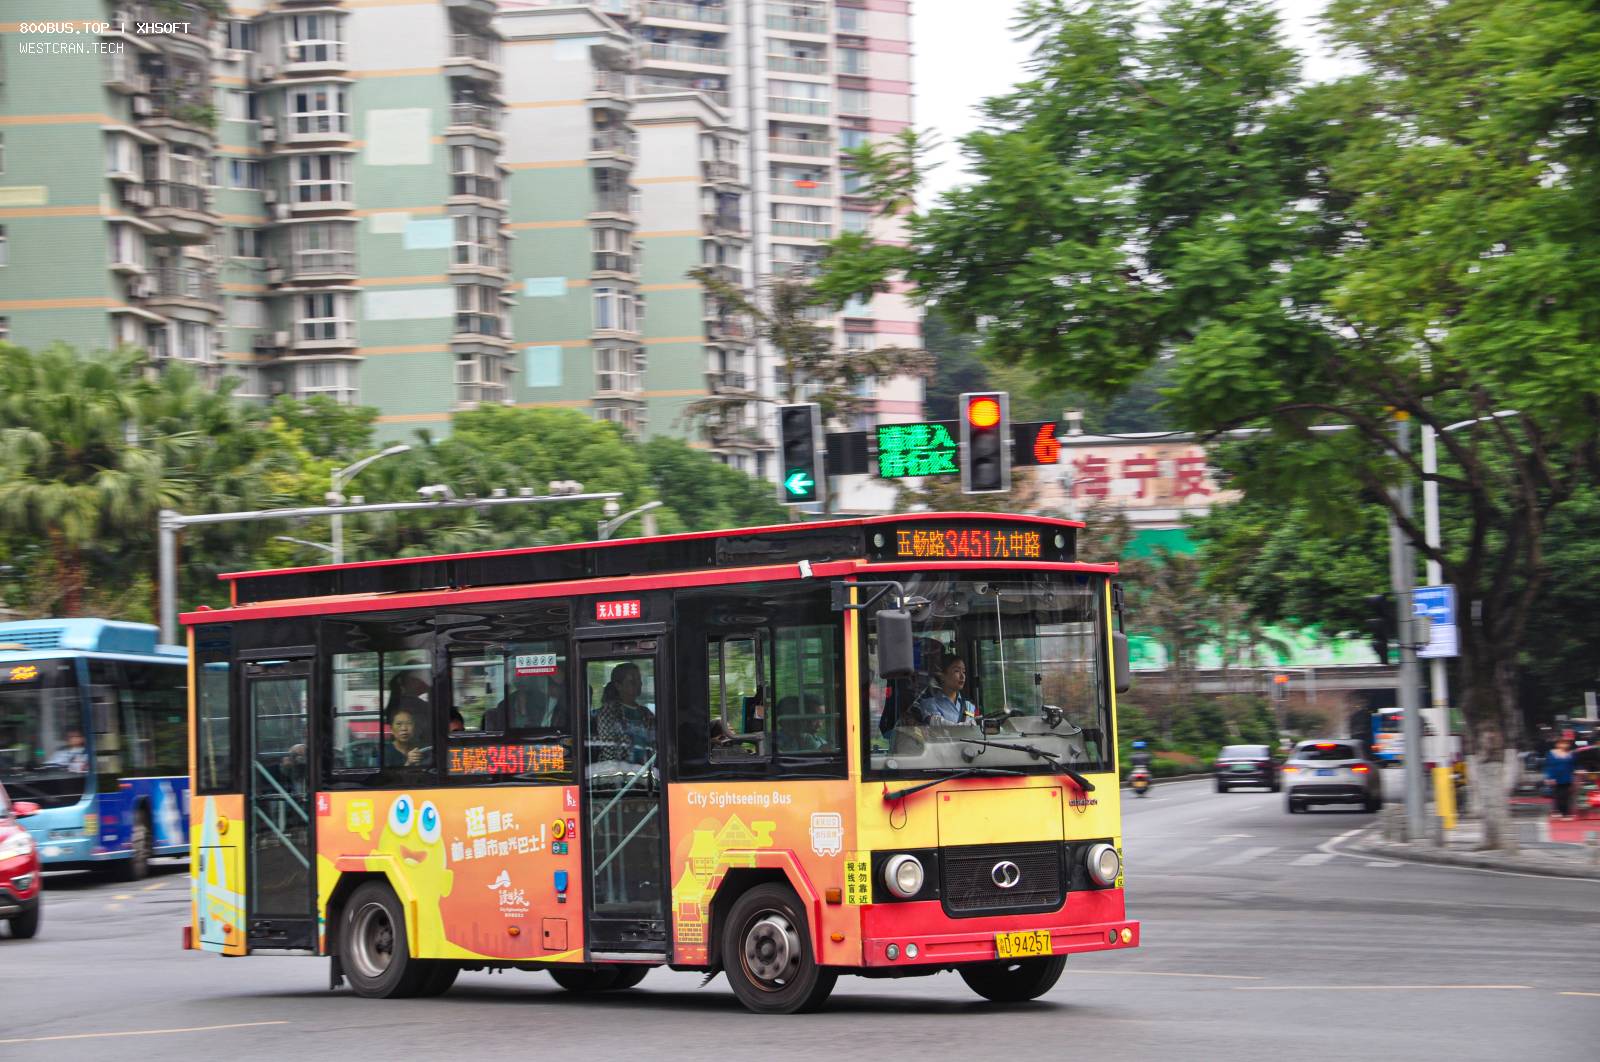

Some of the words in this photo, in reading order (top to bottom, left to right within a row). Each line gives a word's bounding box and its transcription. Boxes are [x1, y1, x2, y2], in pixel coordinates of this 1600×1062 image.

[1034, 424, 1061, 463] 6
[945, 529, 991, 558] 3451
[993, 530, 1041, 558] 九中路
[599, 602, 638, 618] 无人售票车
[487, 744, 525, 774] 3451
[687, 791, 707, 808] City
[709, 791, 770, 808] Sightseeing
[772, 791, 792, 805] Bus
